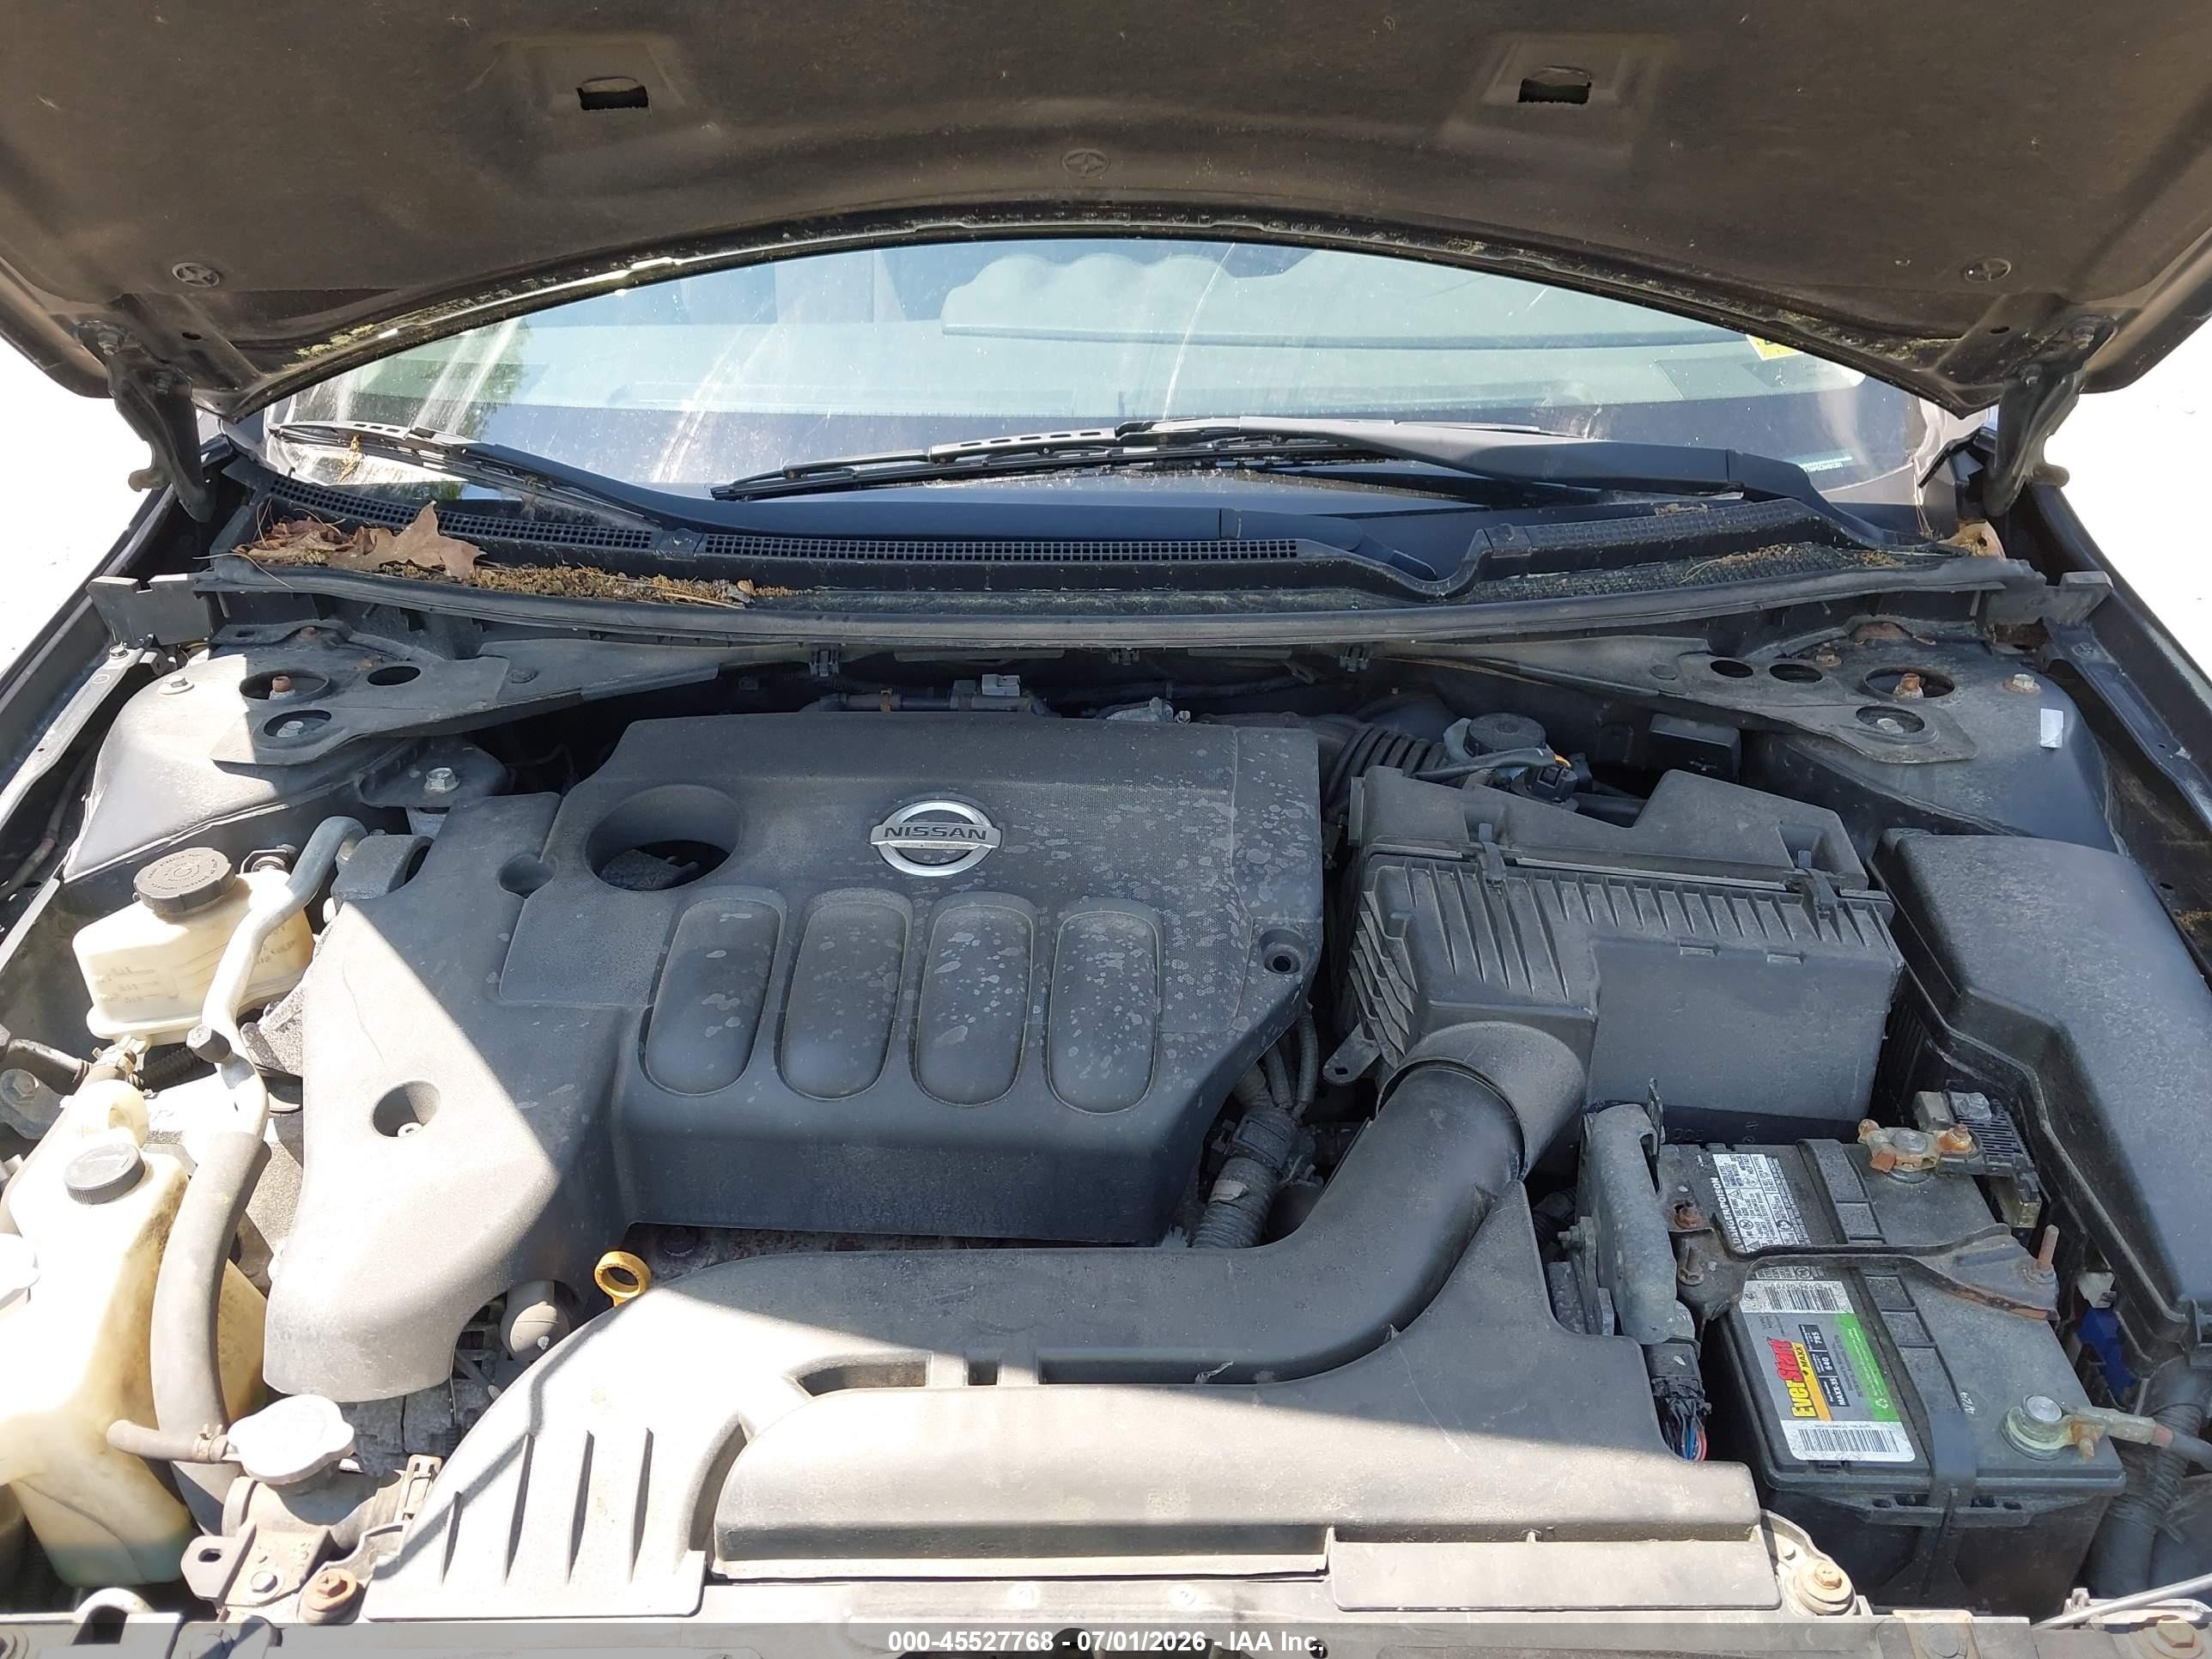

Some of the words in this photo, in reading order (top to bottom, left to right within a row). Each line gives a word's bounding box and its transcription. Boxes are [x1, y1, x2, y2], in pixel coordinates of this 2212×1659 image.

[884, 826, 987, 840] NISSAN
[1711, 1177, 1741, 1243] DANGER/POISON
[1811, 1332, 1822, 1343] 785
[1793, 1346, 1809, 1367] MAXX
[1768, 1338, 1819, 1417] EverStart
[1829, 1377, 1846, 1405] MAXX-35
